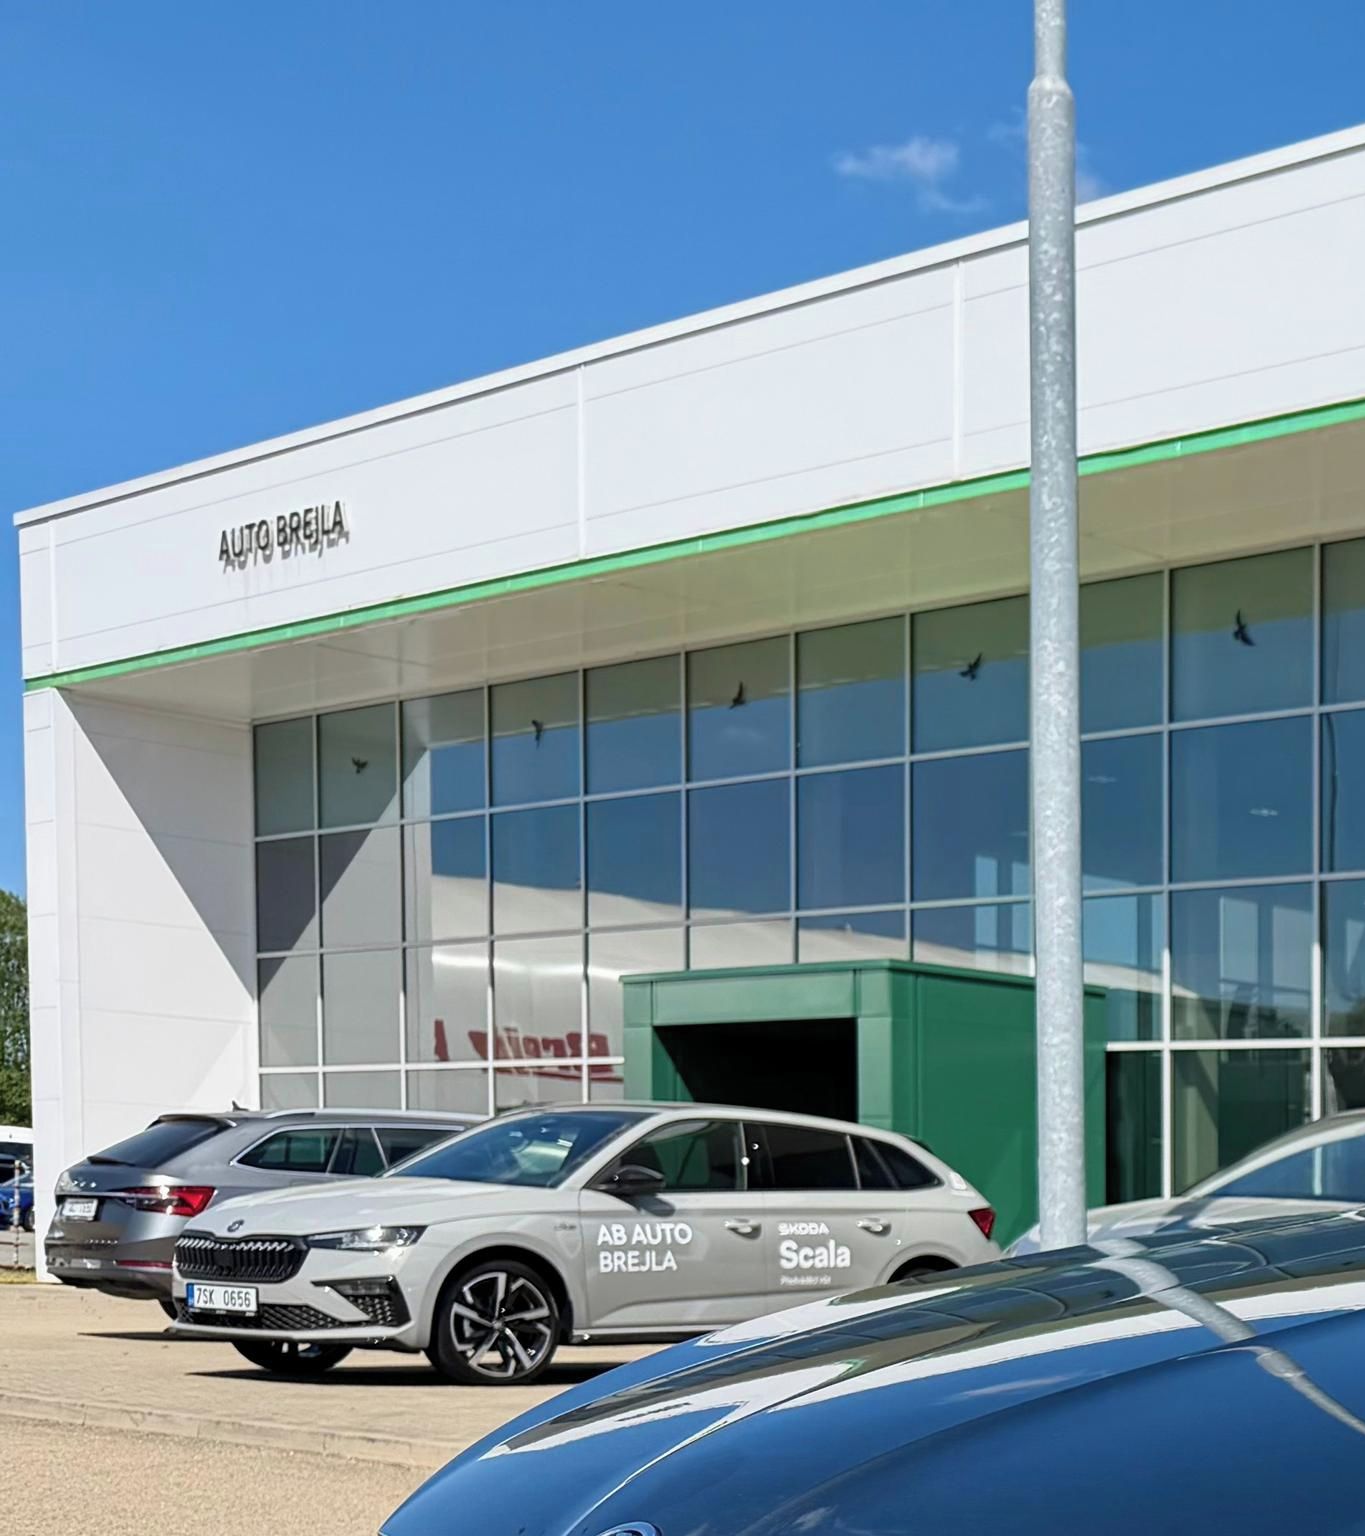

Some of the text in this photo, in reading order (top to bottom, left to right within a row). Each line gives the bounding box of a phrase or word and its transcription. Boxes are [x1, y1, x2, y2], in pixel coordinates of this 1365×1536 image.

[218, 500, 345, 561] AUTO BREJLA
[597, 1223, 692, 1246] AB AUTO
[600, 1250, 678, 1273] BREJLA
[779, 1239, 850, 1269] Scala
[196, 1287, 251, 1308] 7SK 0656
